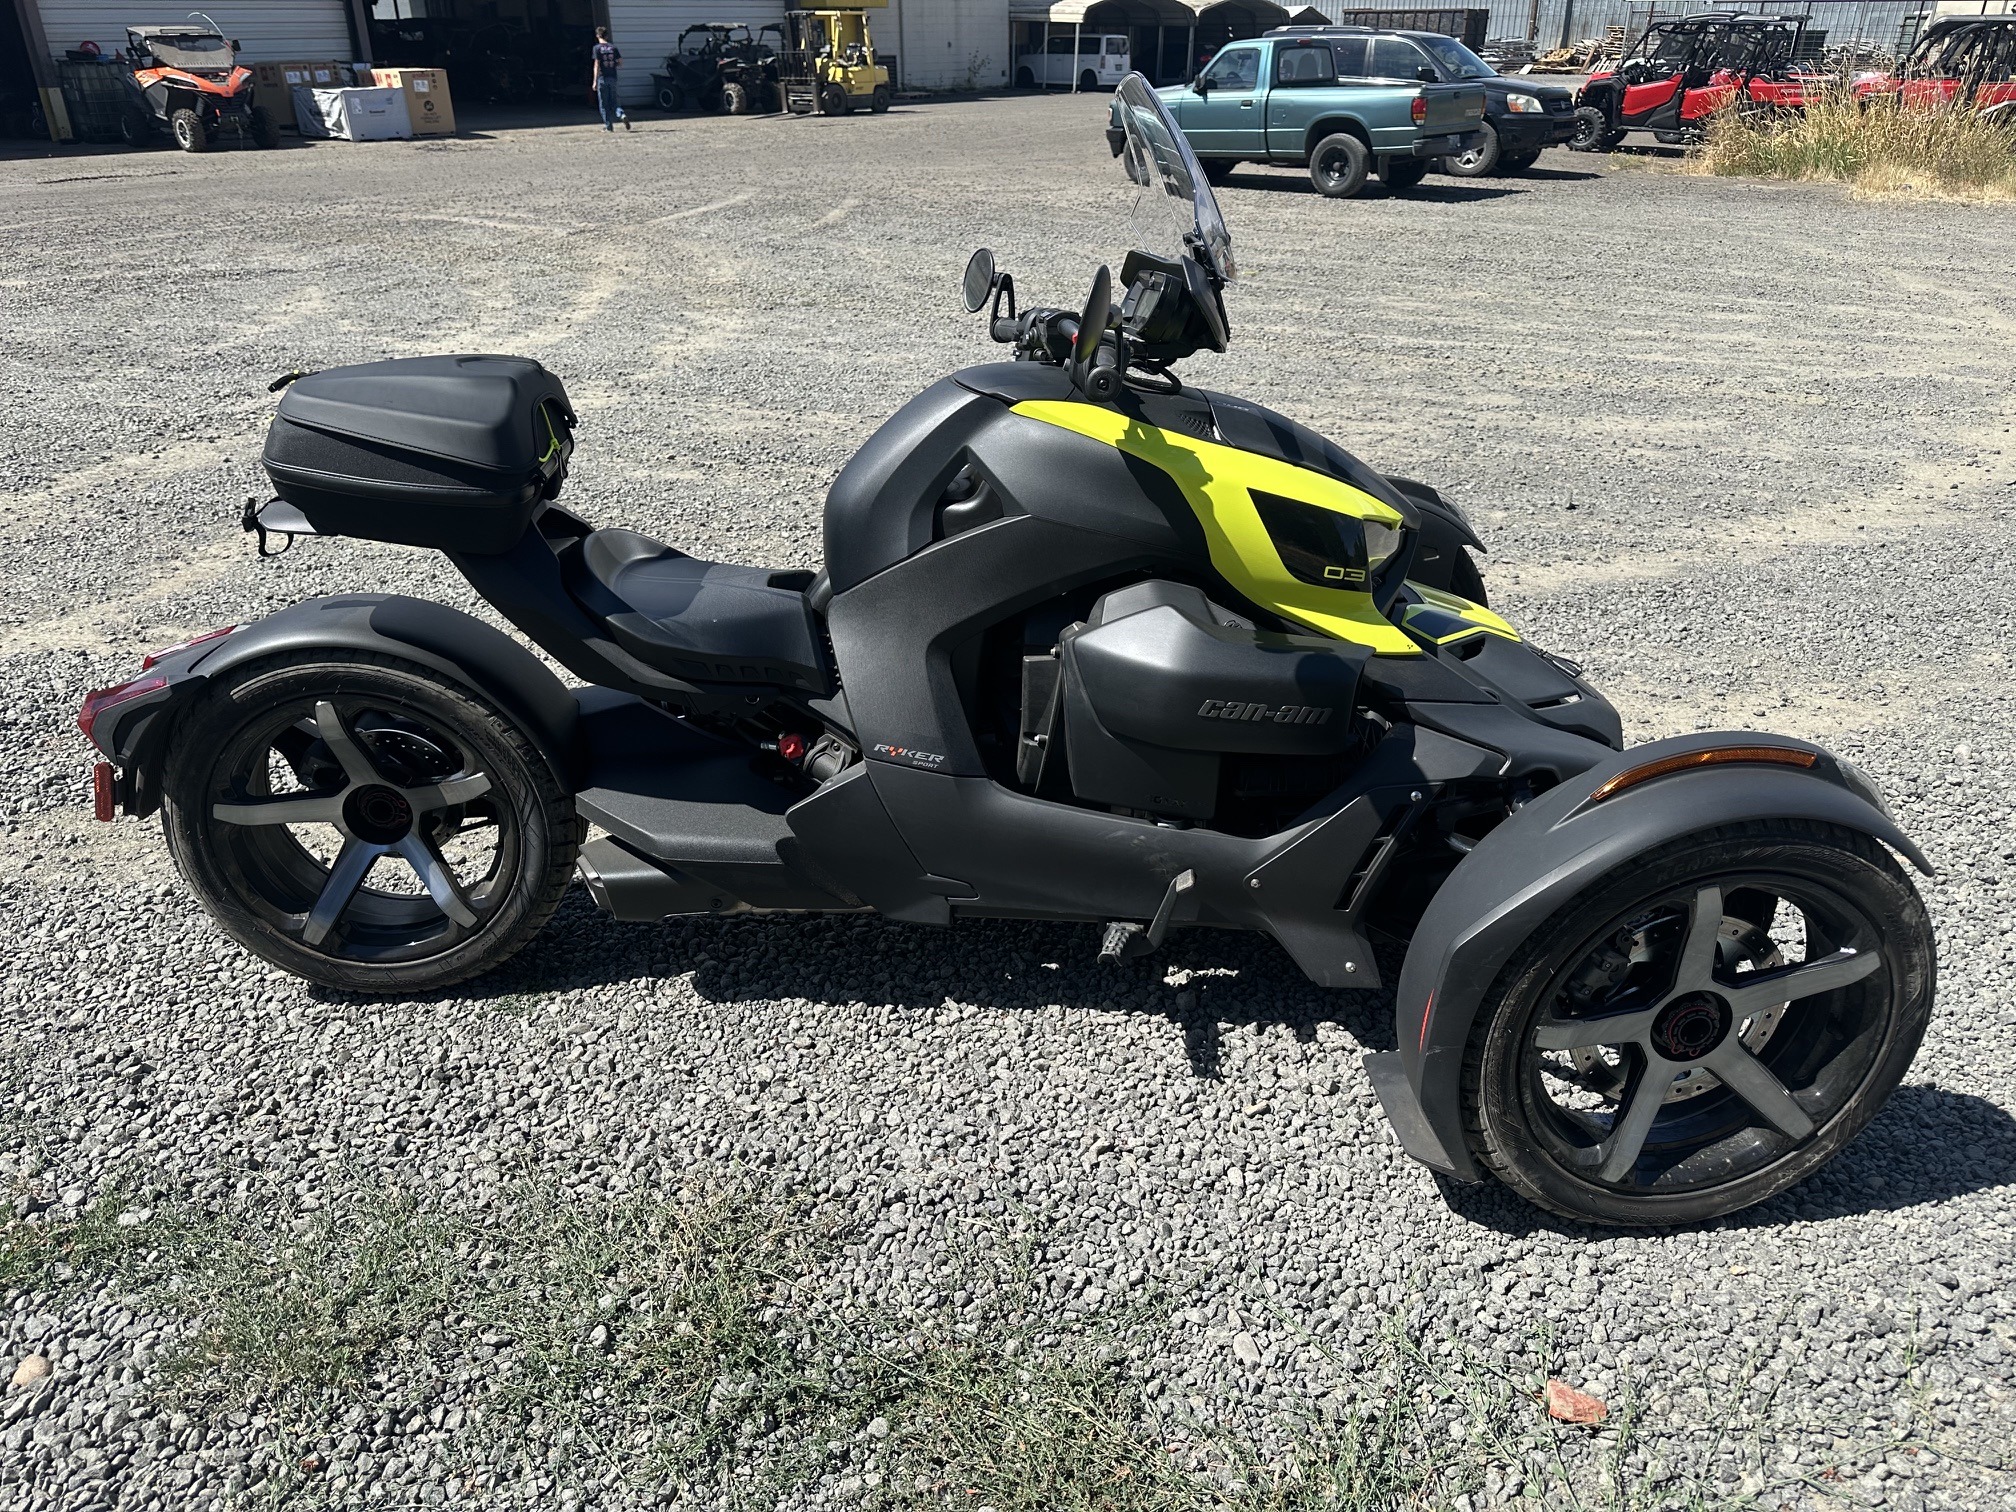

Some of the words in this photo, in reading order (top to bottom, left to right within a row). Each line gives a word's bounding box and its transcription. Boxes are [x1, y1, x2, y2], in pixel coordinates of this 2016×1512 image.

[1323, 565, 1366, 582] 03
[873, 743, 945, 763] RYKER
[912, 760, 939, 769] SPORT
